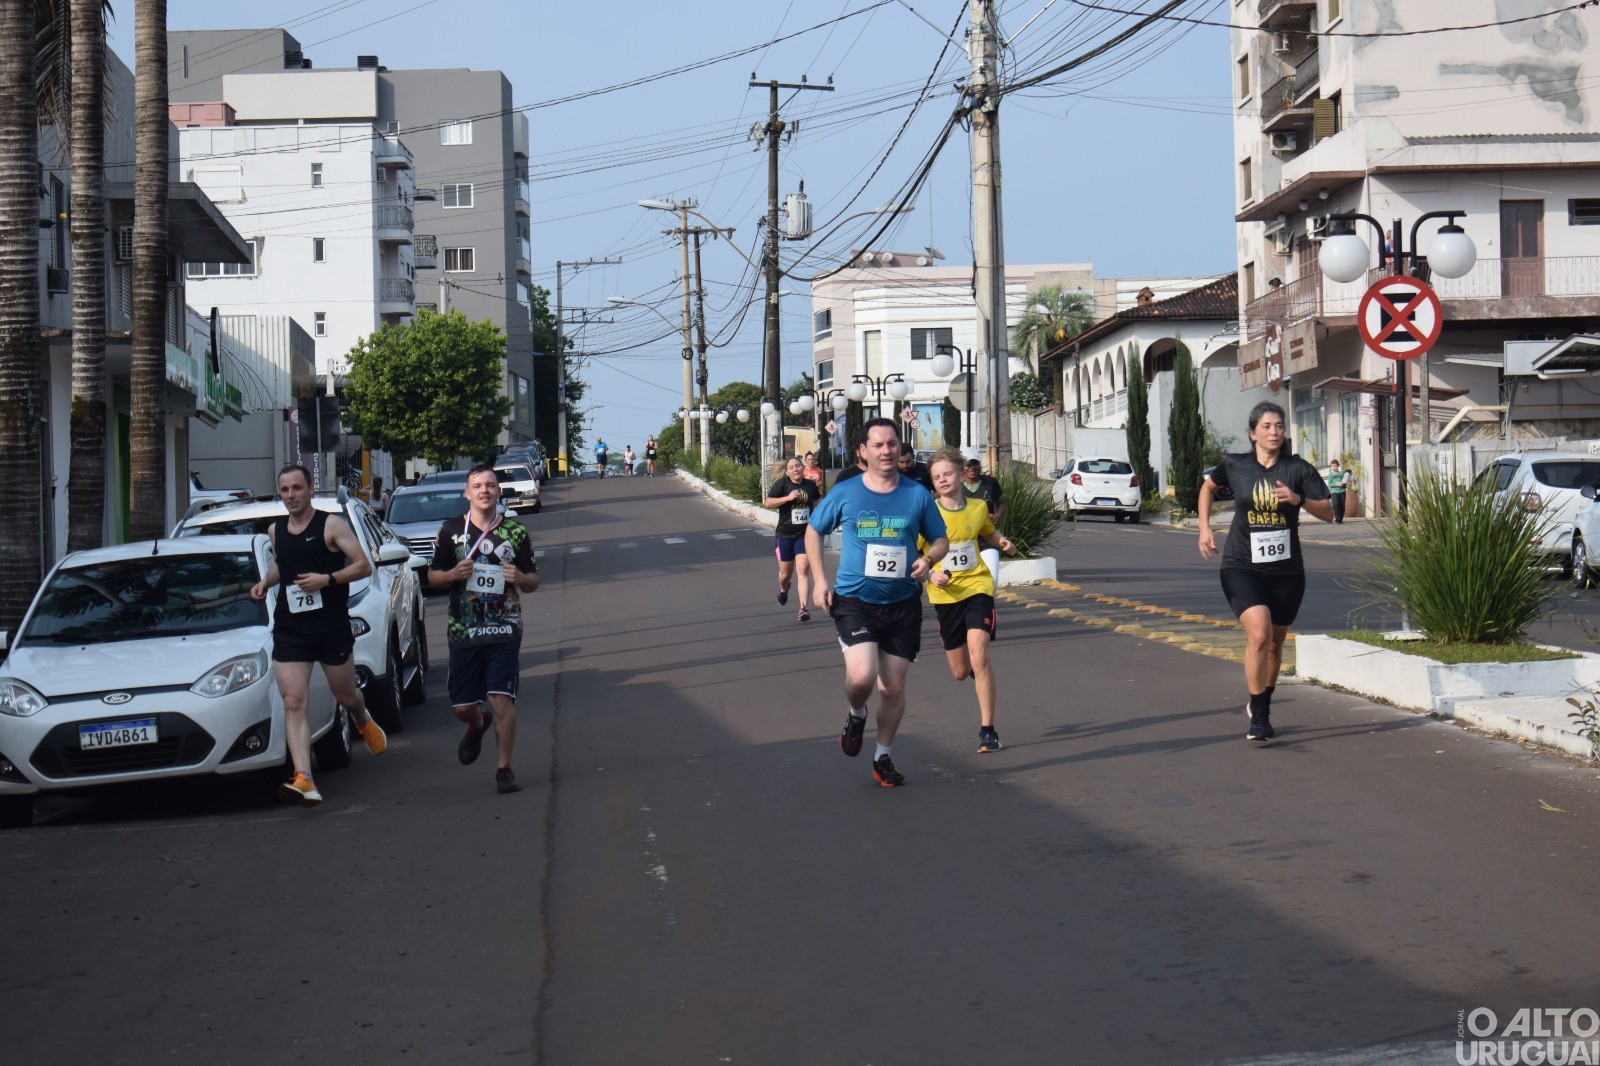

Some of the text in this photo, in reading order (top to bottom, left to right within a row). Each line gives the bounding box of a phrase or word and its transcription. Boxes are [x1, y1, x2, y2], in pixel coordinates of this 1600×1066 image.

[1247, 510, 1287, 525] GARRA
[1258, 543, 1285, 557] 189
[877, 559, 897, 572] 92
[950, 554, 968, 566] 19
[476, 576, 495, 588] 09
[295, 594, 315, 608] 78
[477, 625, 513, 636] SICOOB
[88, 728, 149, 746] IVD4B61
